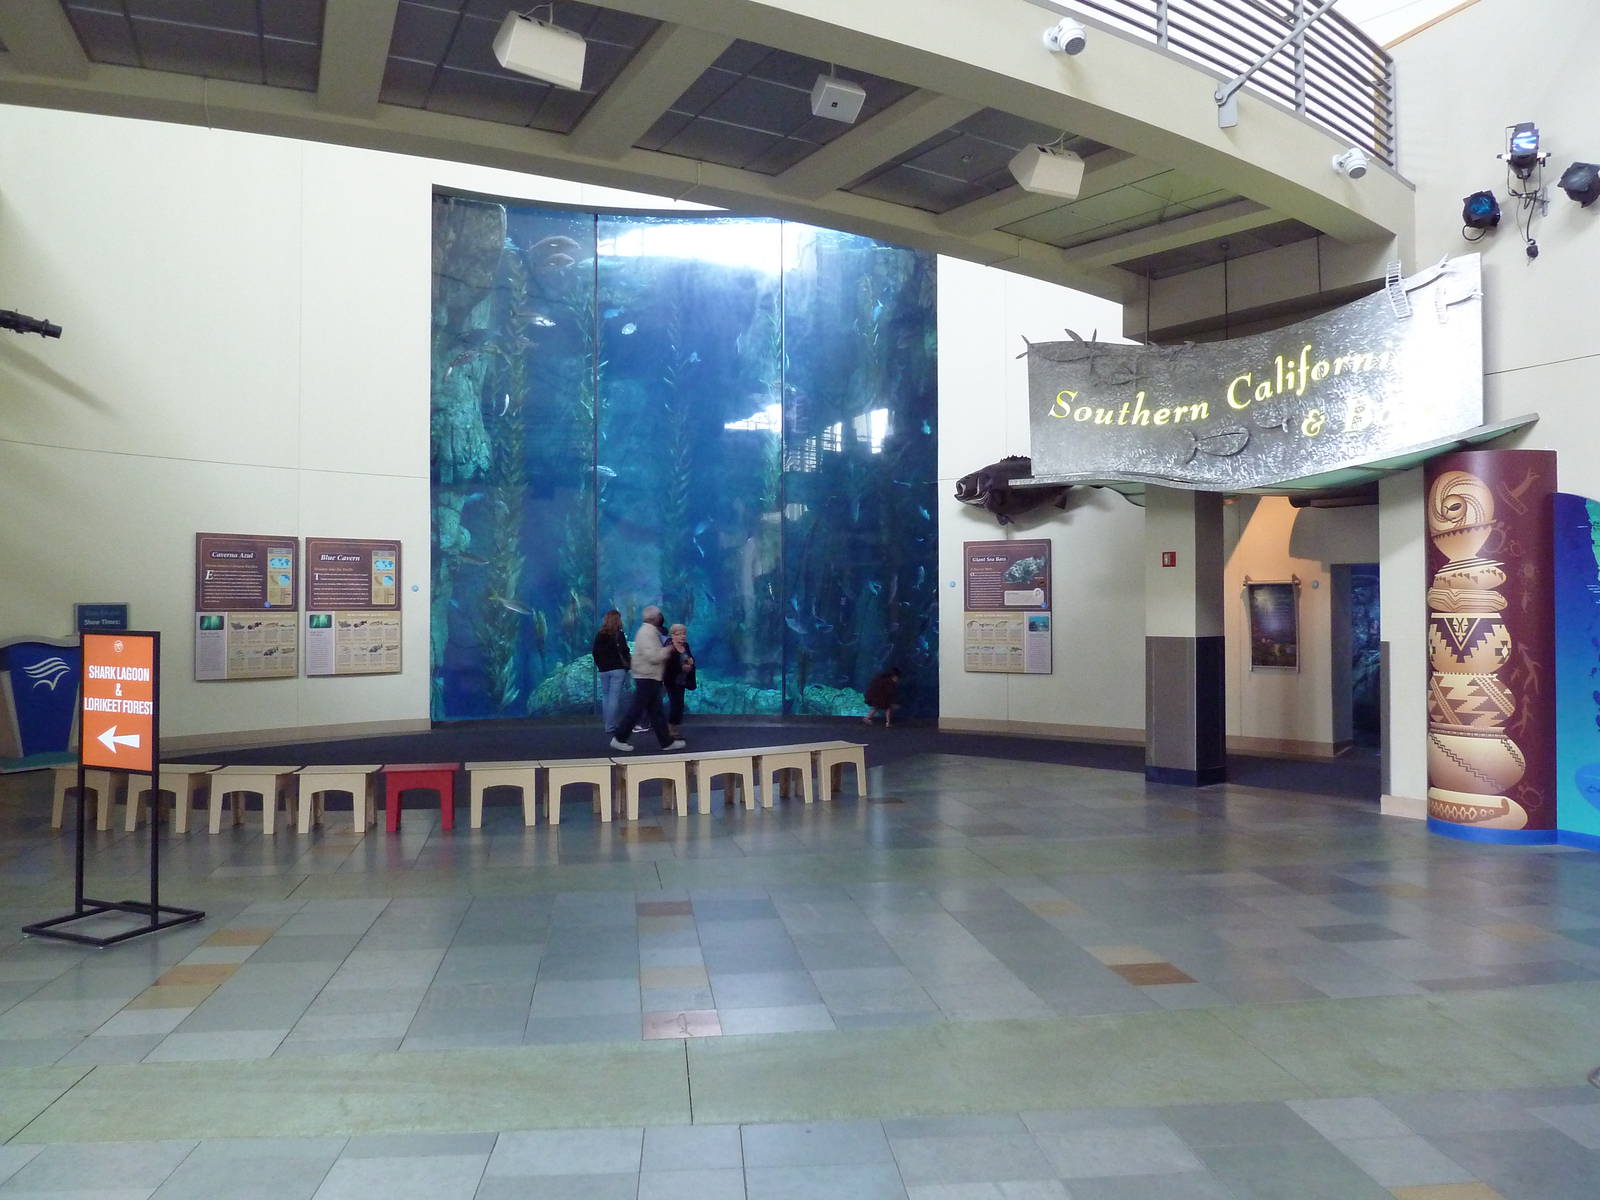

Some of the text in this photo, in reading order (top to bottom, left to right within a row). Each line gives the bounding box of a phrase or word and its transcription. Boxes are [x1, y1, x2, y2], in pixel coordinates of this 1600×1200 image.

[1048, 390, 1210, 426] Southern
[1301, 409, 1326, 437] &
[211, 551, 238, 559] Caverna
[88, 665, 150, 682] SHARK LAGOON
[115, 683, 123, 697] &
[84, 697, 122, 712] LORIKEET
